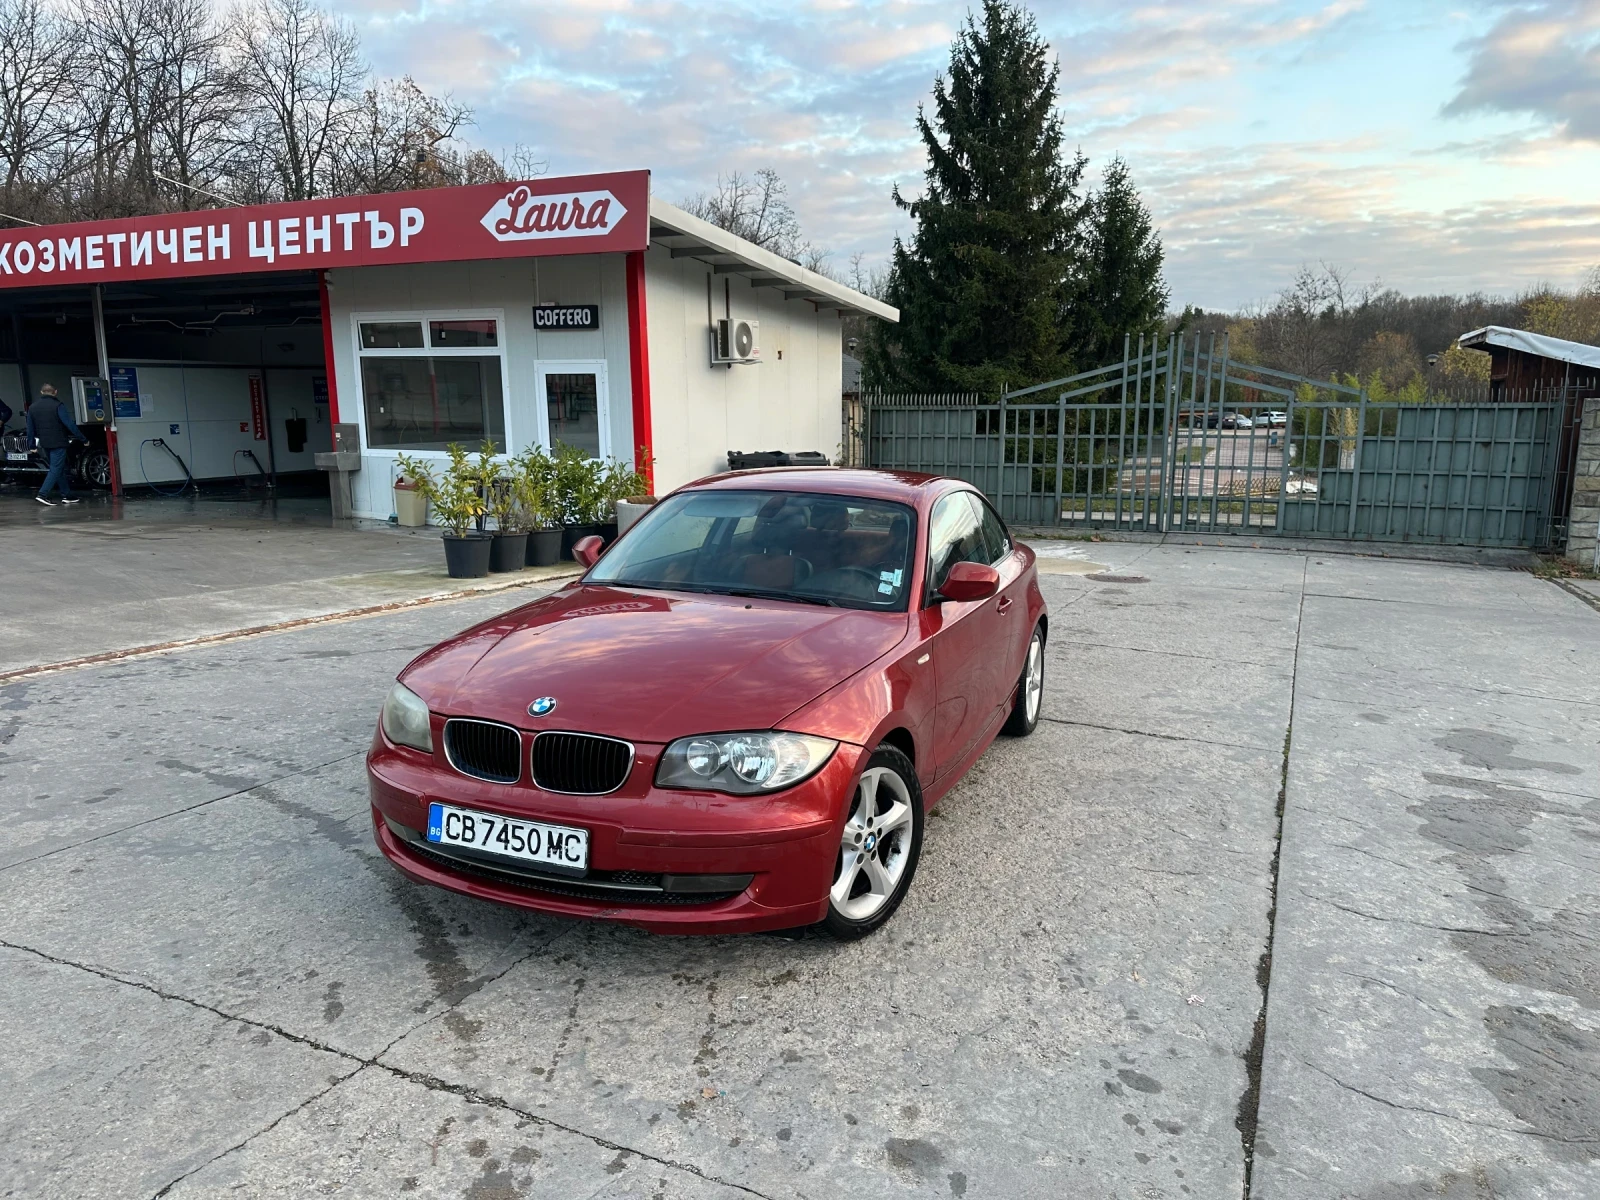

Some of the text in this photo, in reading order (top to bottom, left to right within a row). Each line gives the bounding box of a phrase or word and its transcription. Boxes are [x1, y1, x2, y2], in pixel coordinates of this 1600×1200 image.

[495, 188, 611, 235] Laura
[0, 207, 425, 275] КОЗМЕТИЧЕН ЦЕНТЪР
[535, 308, 591, 326] COFFERO
[430, 826, 441, 836] BG
[445, 812, 581, 862] CB 7450 MC
